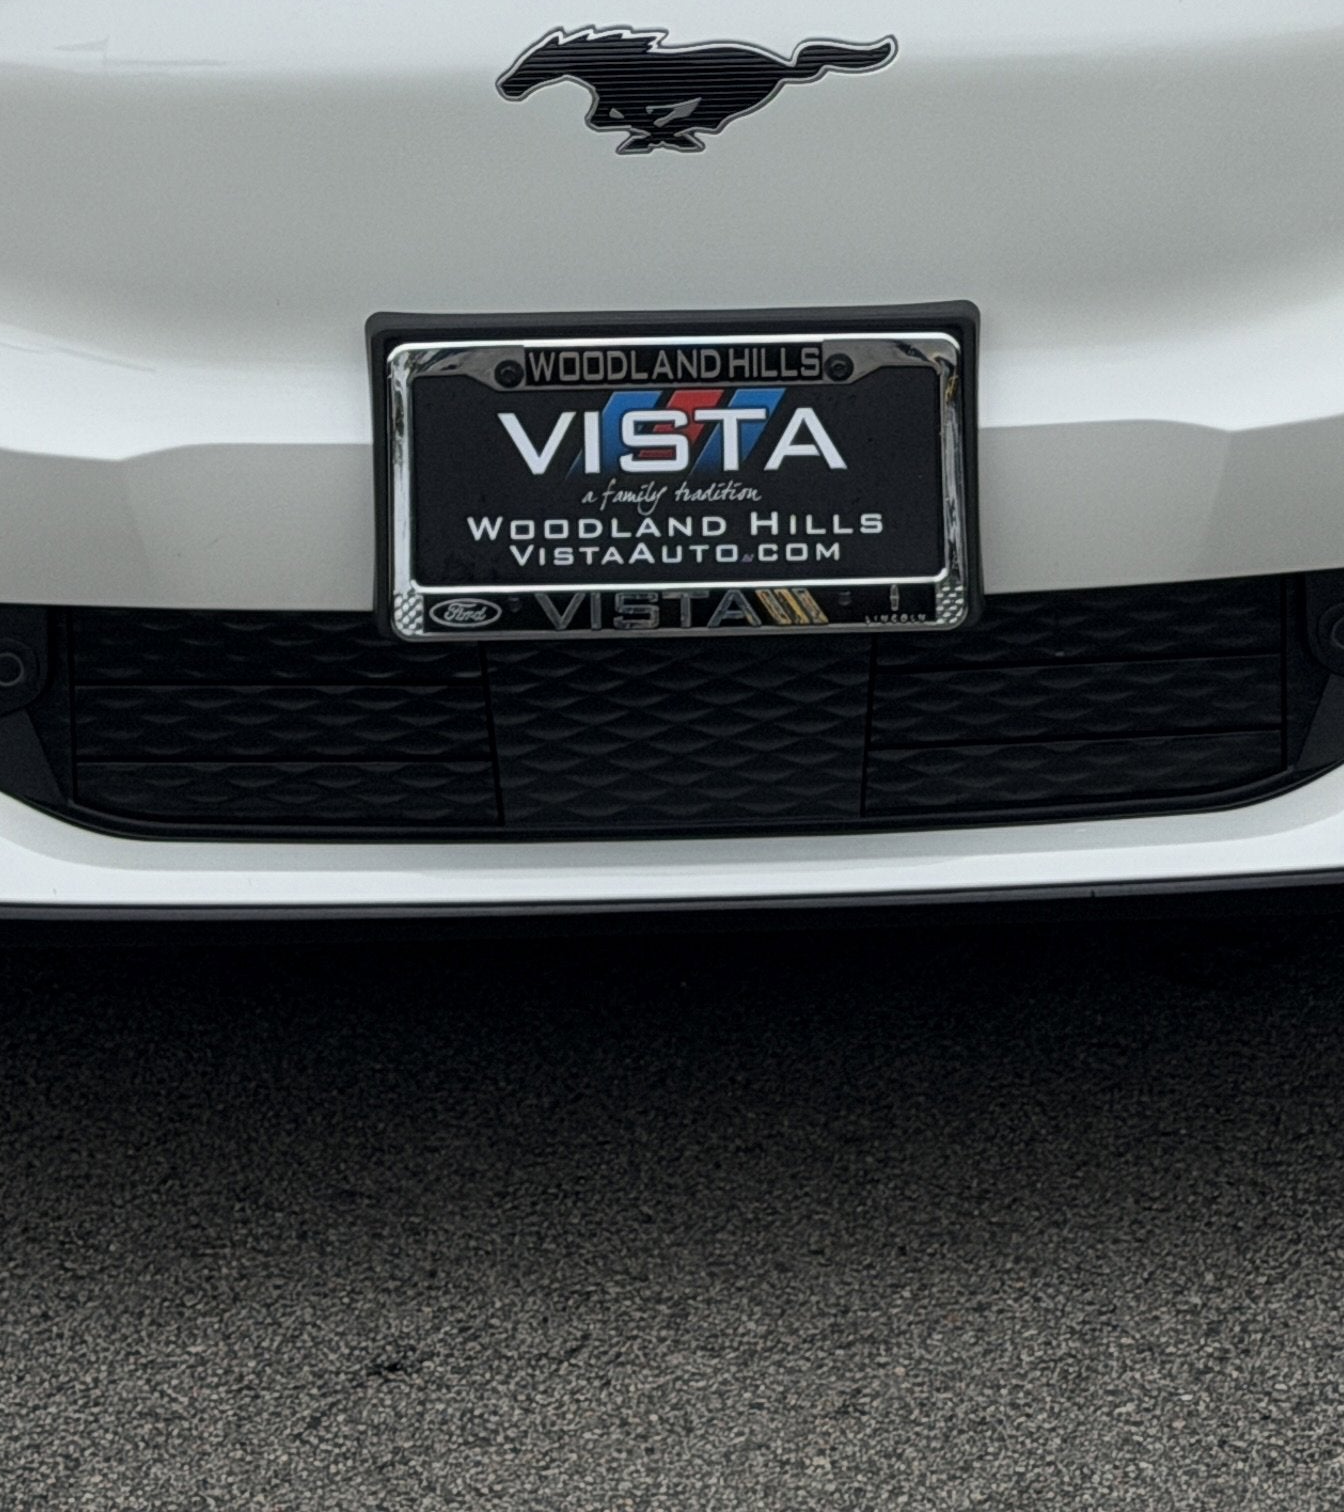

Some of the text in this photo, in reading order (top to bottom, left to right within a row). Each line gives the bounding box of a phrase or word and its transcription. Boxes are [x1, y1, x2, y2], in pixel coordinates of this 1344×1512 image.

[528, 346, 822, 383] WOODLAND HILLS
[497, 406, 849, 476] VISTA
[581, 477, 763, 516] a family tradition
[443, 588, 929, 631] Ford VISTA LINCOLN
